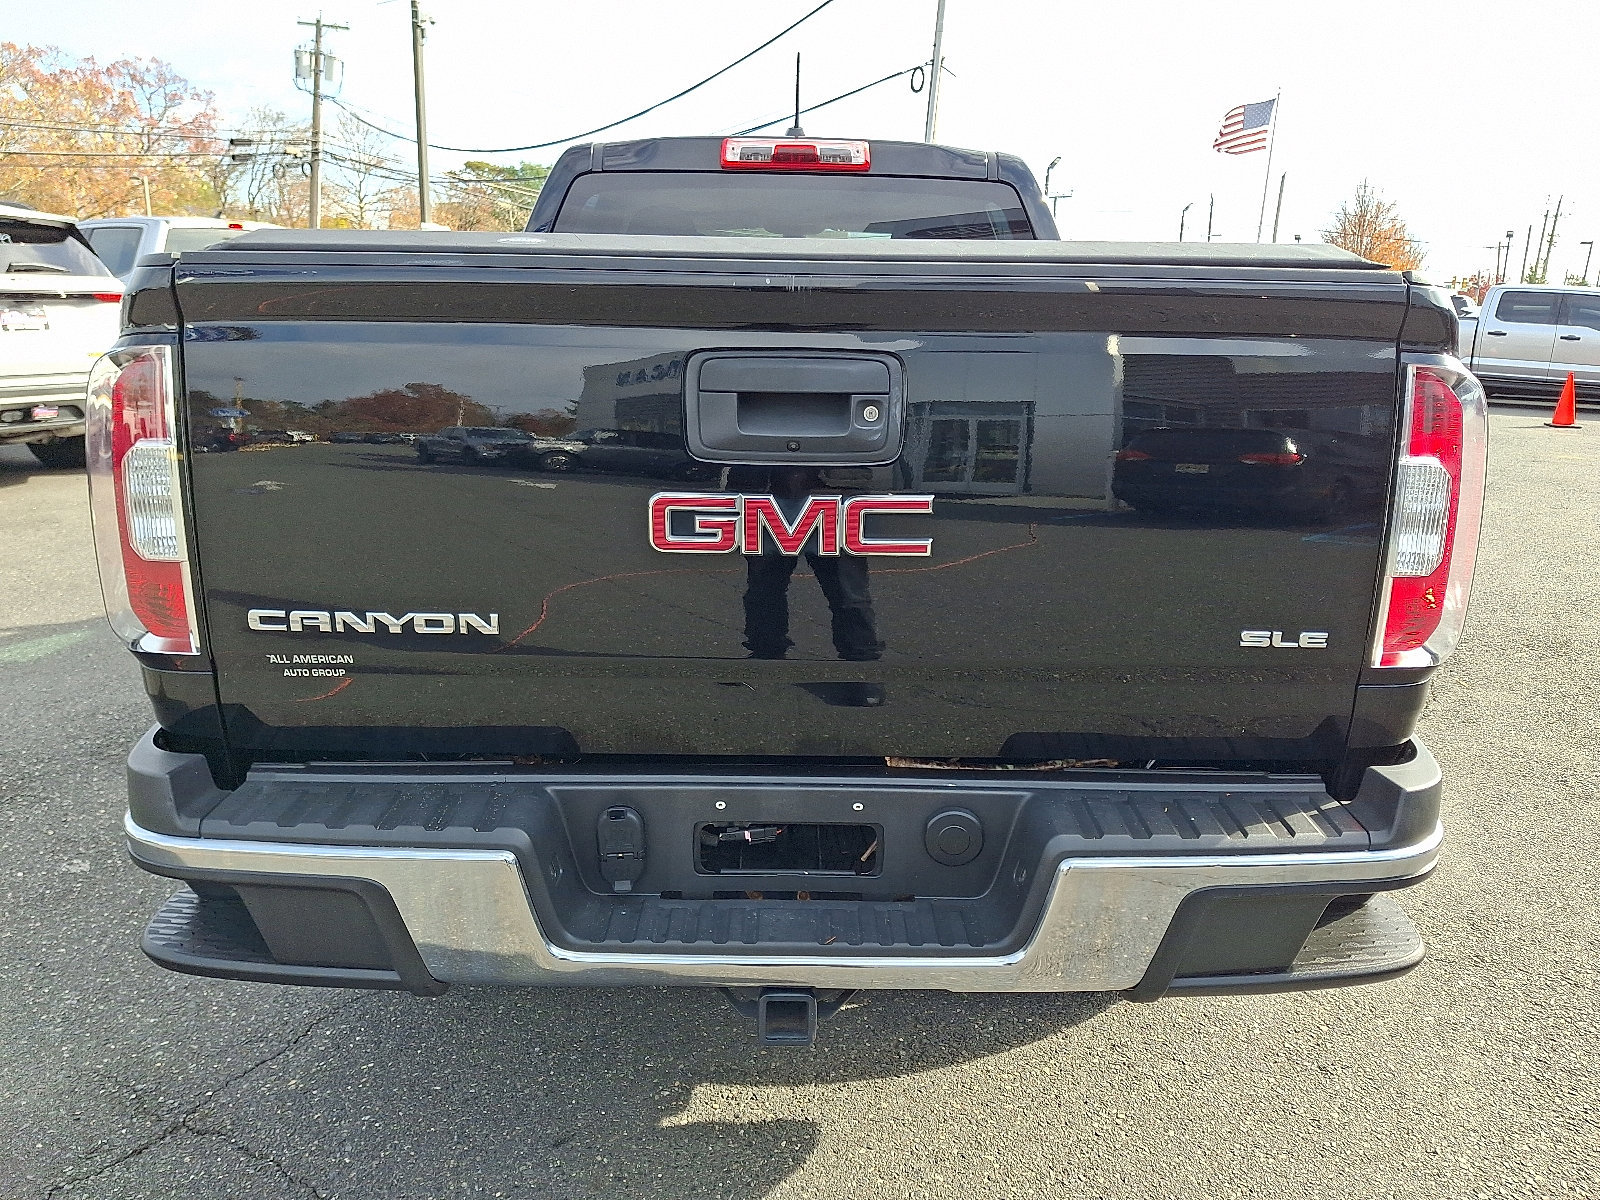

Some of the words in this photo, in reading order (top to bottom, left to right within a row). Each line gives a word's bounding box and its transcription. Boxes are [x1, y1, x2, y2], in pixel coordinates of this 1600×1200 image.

[649, 491, 935, 556] GMC
[247, 608, 500, 635] CANYON
[1239, 630, 1329, 648] SLE
[269, 654, 291, 664] ALL
[292, 654, 354, 664] AMERICAN
[283, 668, 310, 677] AUTO
[311, 668, 346, 677] GROUP
